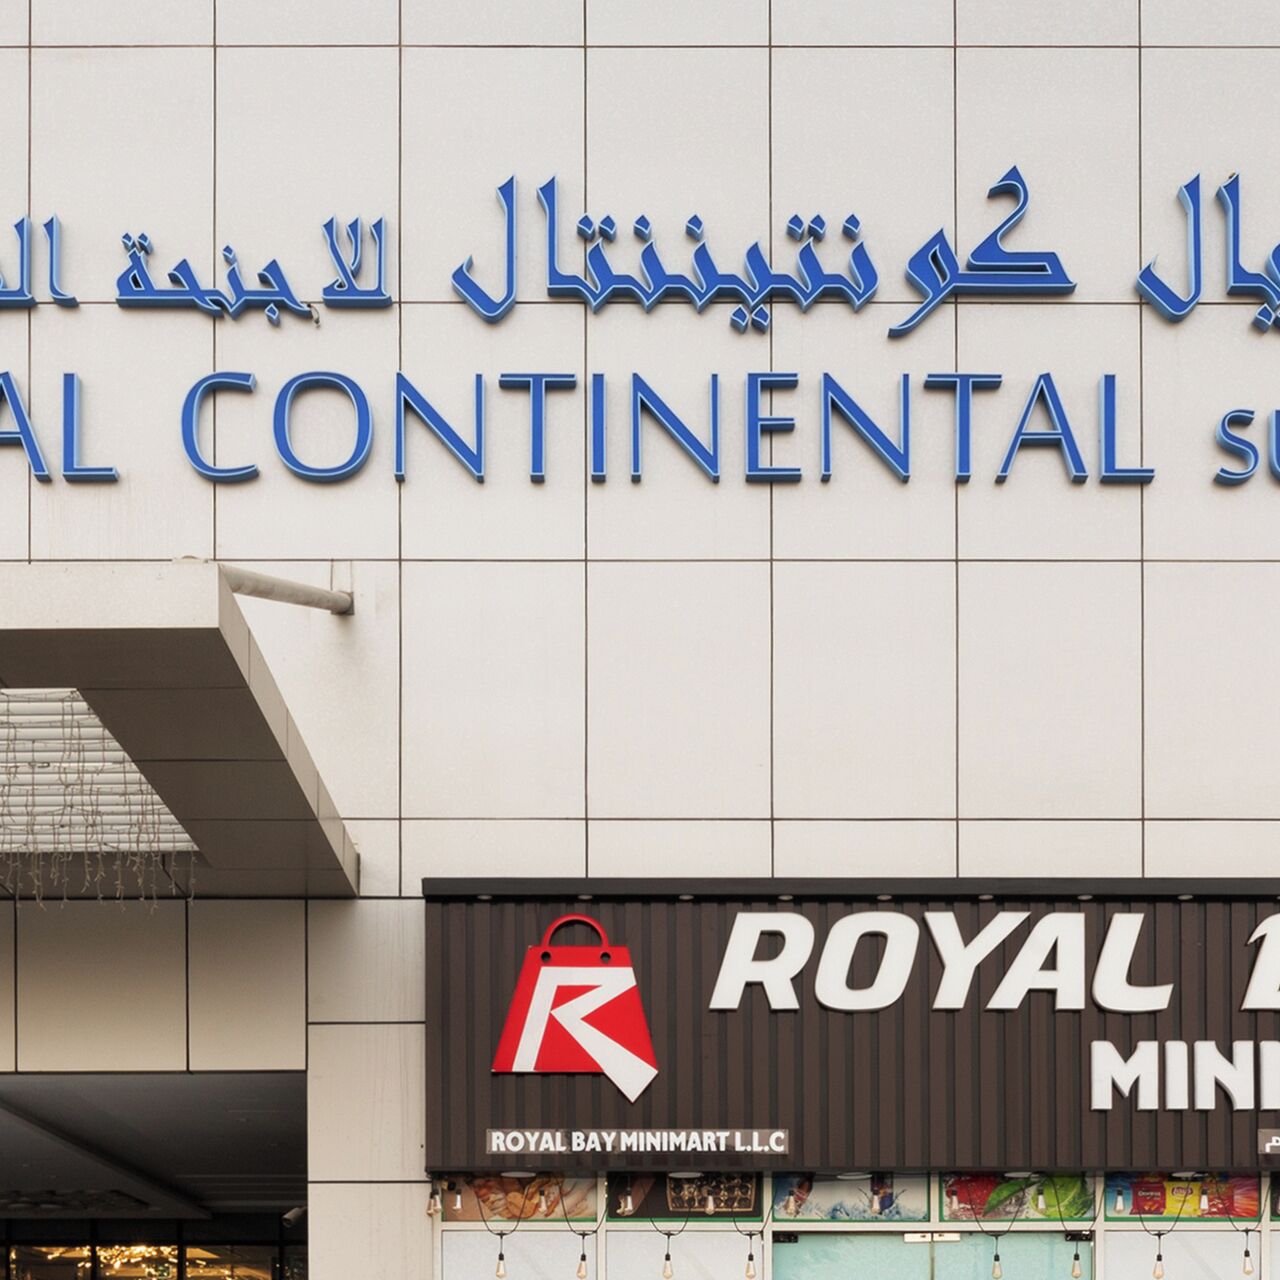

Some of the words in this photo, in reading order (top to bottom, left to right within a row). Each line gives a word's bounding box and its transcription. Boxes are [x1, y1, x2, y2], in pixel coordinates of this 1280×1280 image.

[452, 166, 1076, 337] كونتيننتال
[181, 371, 1155, 482] CONTINENTAL
[709, 911, 1174, 1012] ROYAL
[491, 1131, 566, 1152] ROYAL
[572, 1131, 617, 1152] BAY
[620, 1131, 730, 1152] MINIMART
[735, 1131, 785, 1152] L.L.C
